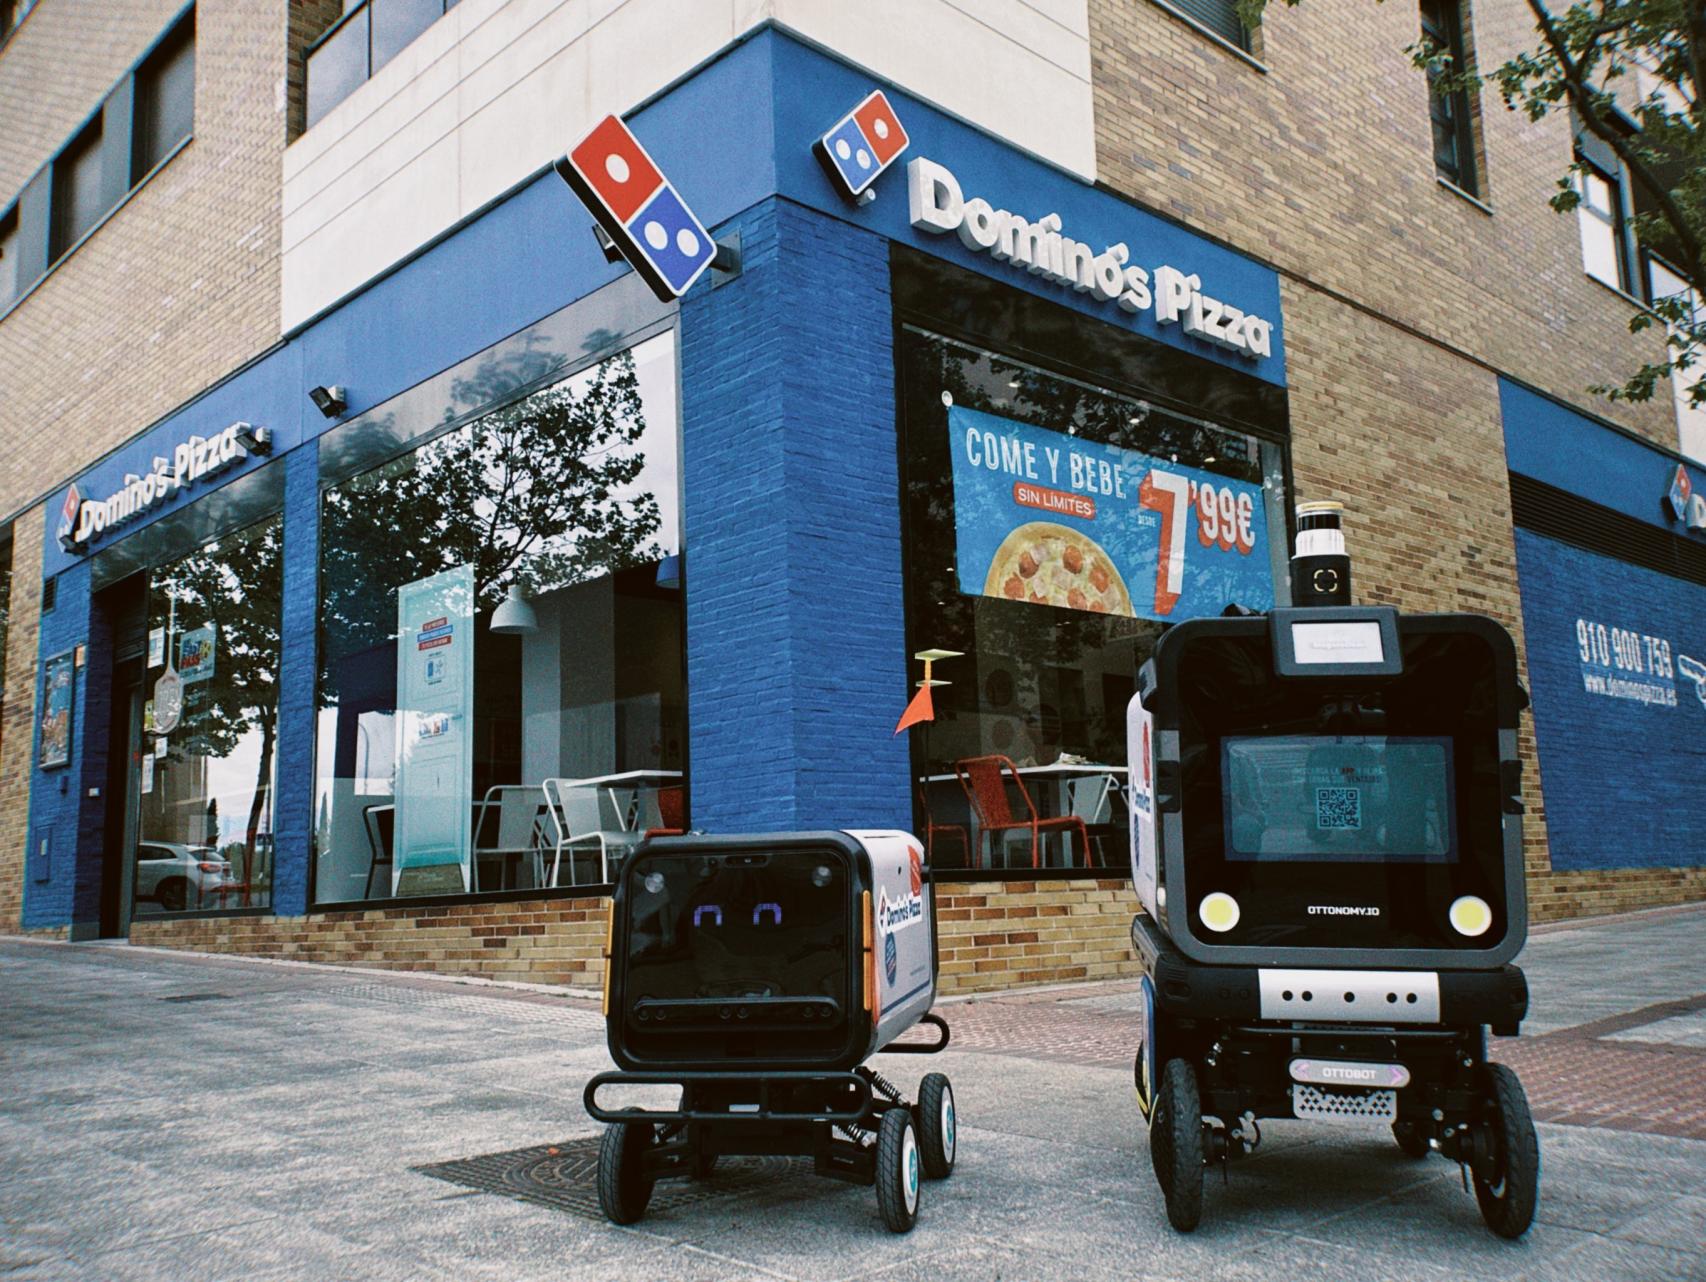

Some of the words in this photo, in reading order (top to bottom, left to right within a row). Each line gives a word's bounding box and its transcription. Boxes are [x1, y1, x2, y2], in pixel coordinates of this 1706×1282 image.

[907, 156, 1152, 314] Domino's
[1154, 265, 1272, 361] Pizza
[75, 457, 174, 544] Domino's
[174, 421, 251, 488] Pizza
[966, 427, 1039, 480] COME
[1044, 446, 1060, 484] Y
[1069, 452, 1127, 499] BEBE
[1018, 488, 1041, 504] SIN
[1576, 619, 1610, 667] 910
[1611, 627, 1644, 673] 900
[1643, 635, 1674, 679] 759
[1307, 905, 1380, 916] OTTONOMY.IO
[1322, 1067, 1377, 1080] OTTOBOT
